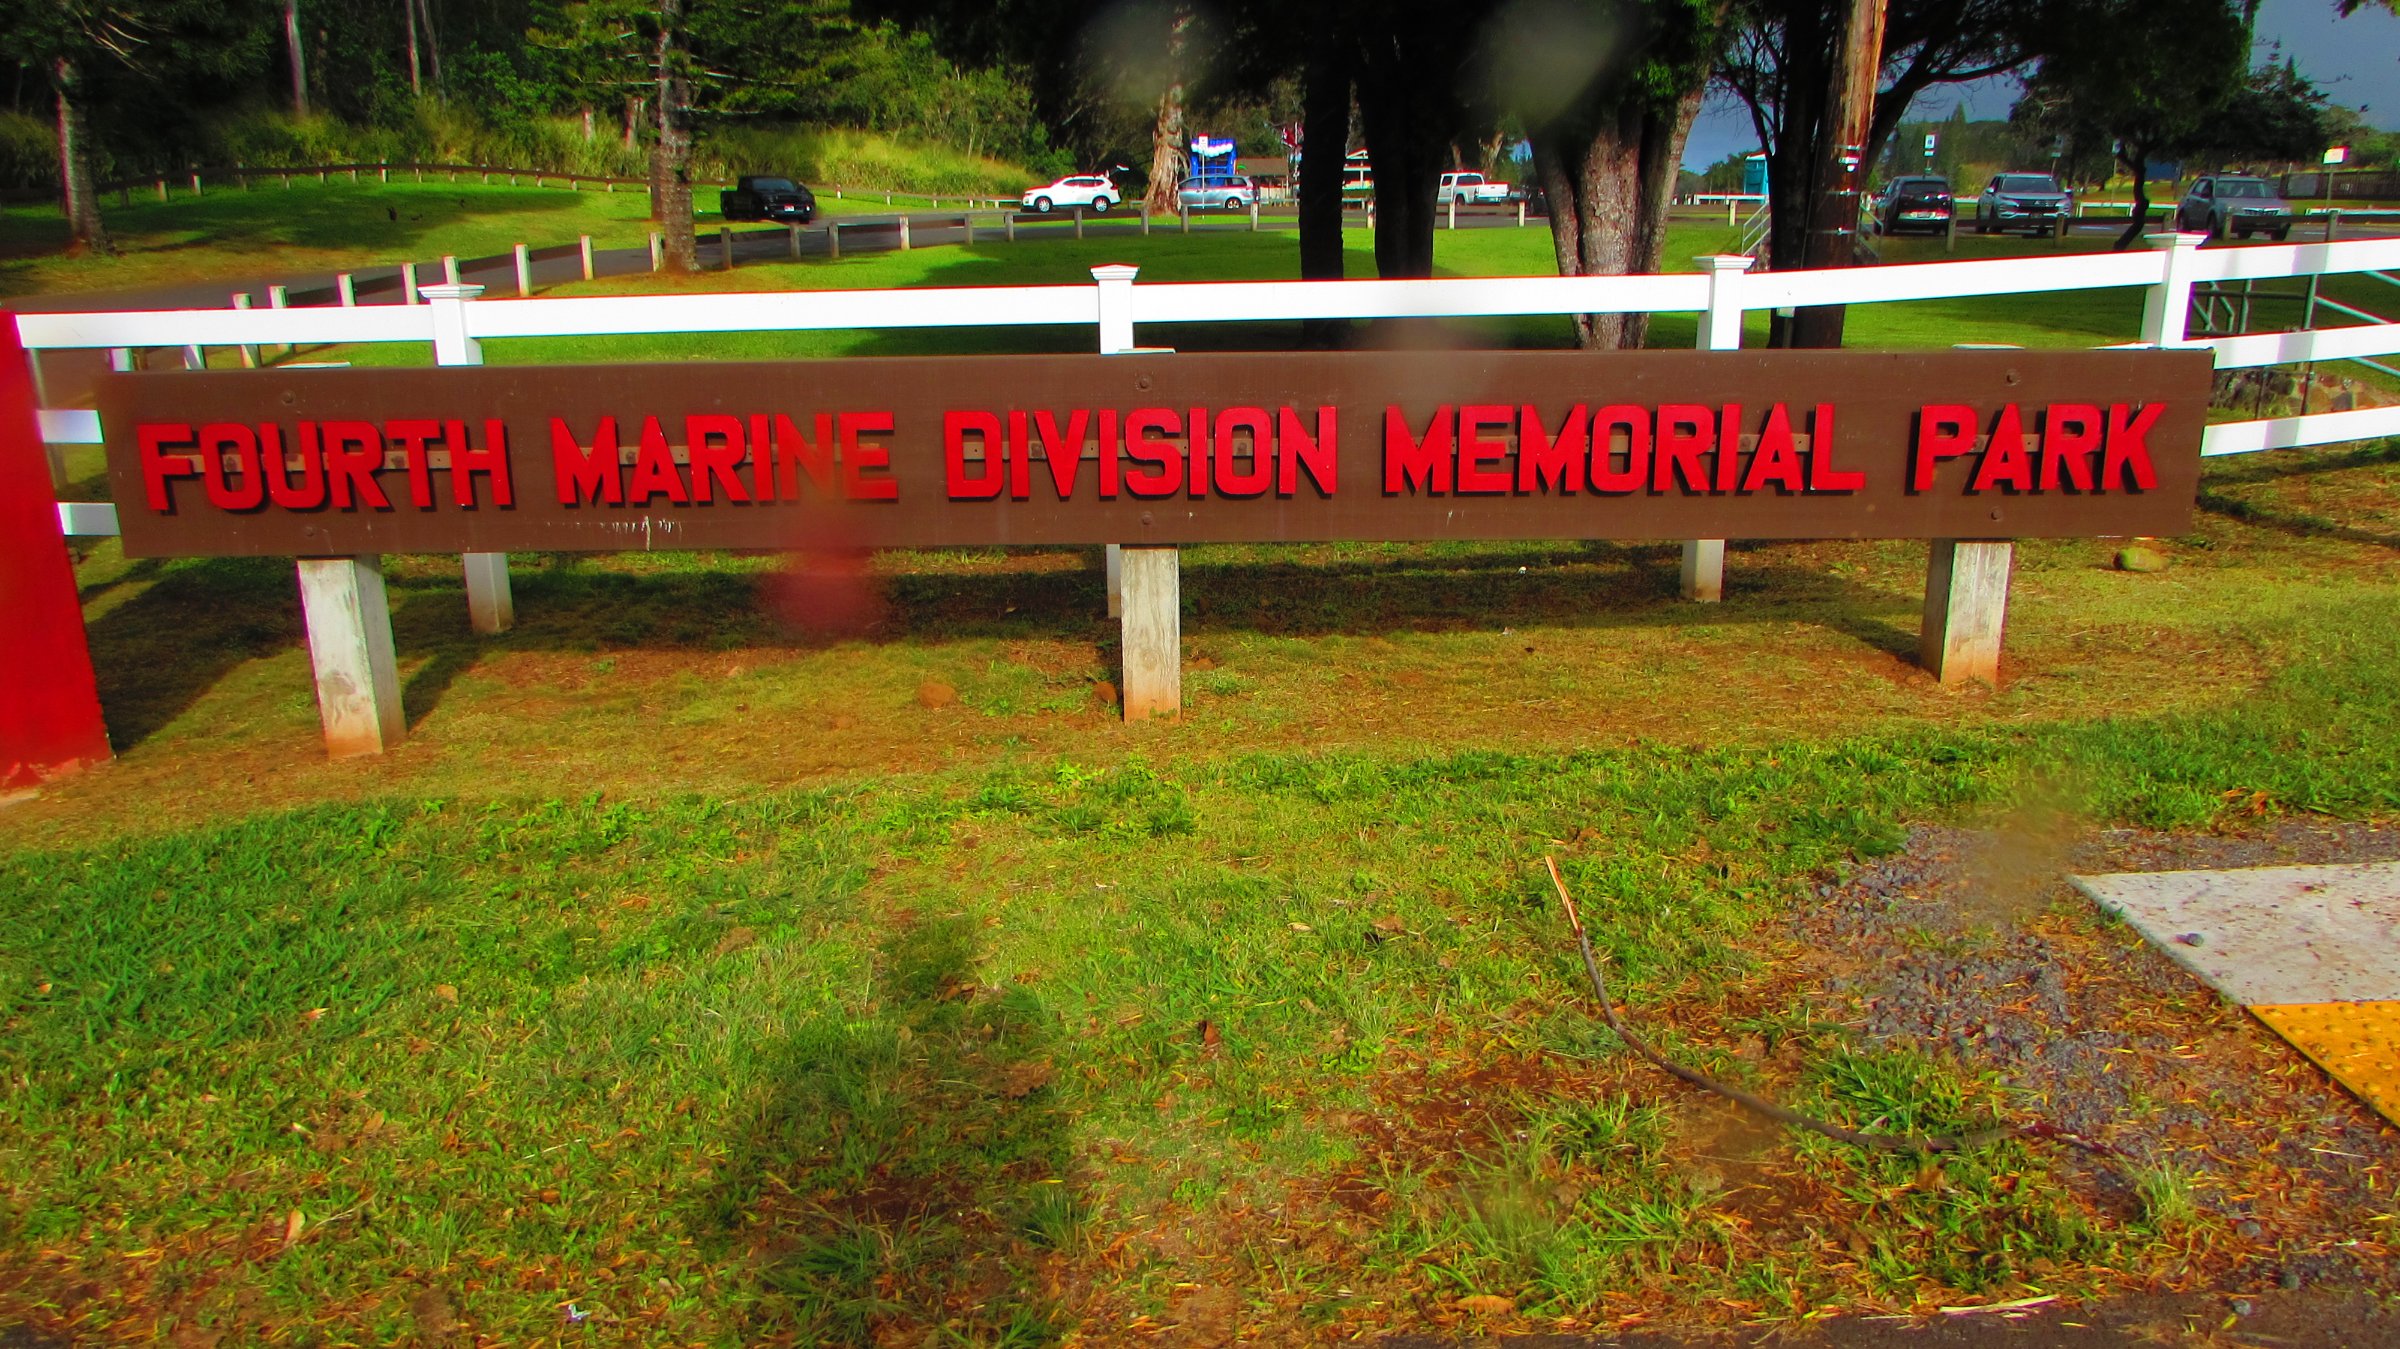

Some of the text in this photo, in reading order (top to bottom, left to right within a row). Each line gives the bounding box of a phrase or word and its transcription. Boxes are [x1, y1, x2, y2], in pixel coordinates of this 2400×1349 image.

[138, 402, 2167, 511] FOURTH MARINE DIVISION MEMORIAL PARK
